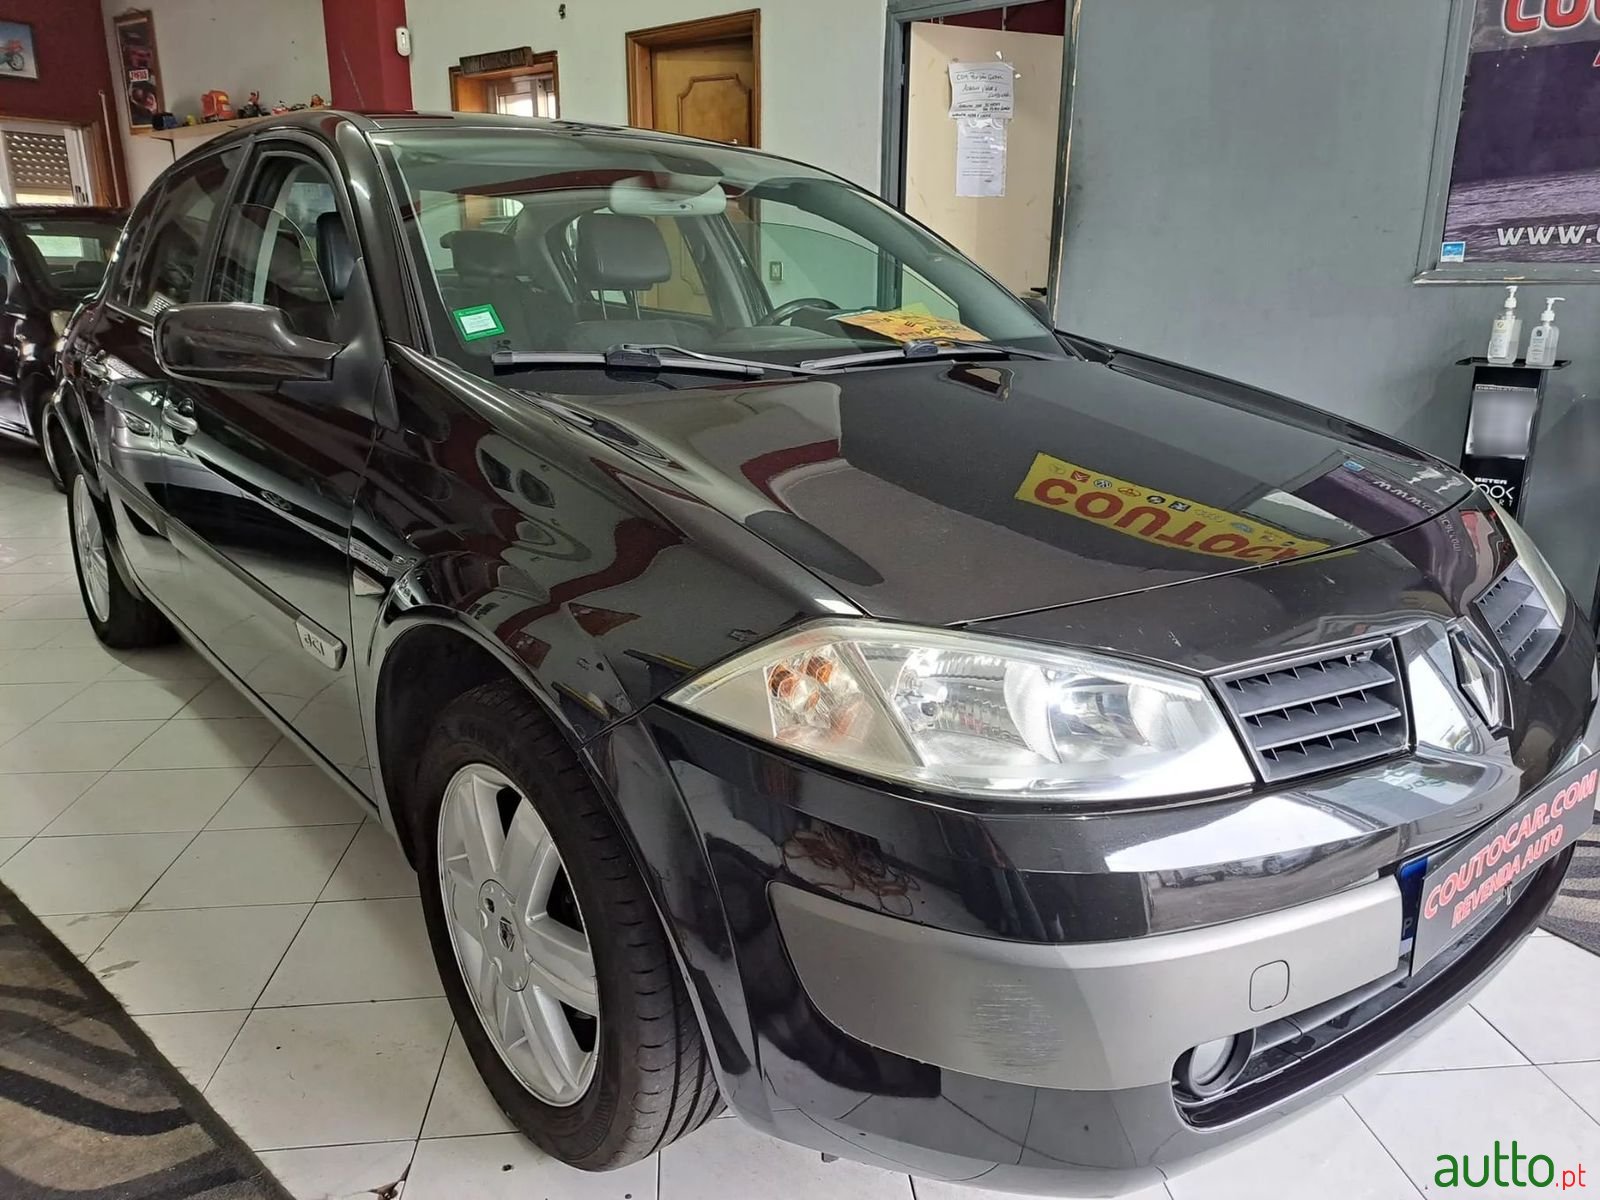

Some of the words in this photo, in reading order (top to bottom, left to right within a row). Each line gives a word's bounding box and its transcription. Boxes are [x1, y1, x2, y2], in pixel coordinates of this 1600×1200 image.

[1502, 0, 1600, 35] CO
[1424, 768, 1598, 919] COUTOCAR.COM
[1451, 855, 1520, 929] REVENDA
[1521, 824, 1563, 870] AUTO
